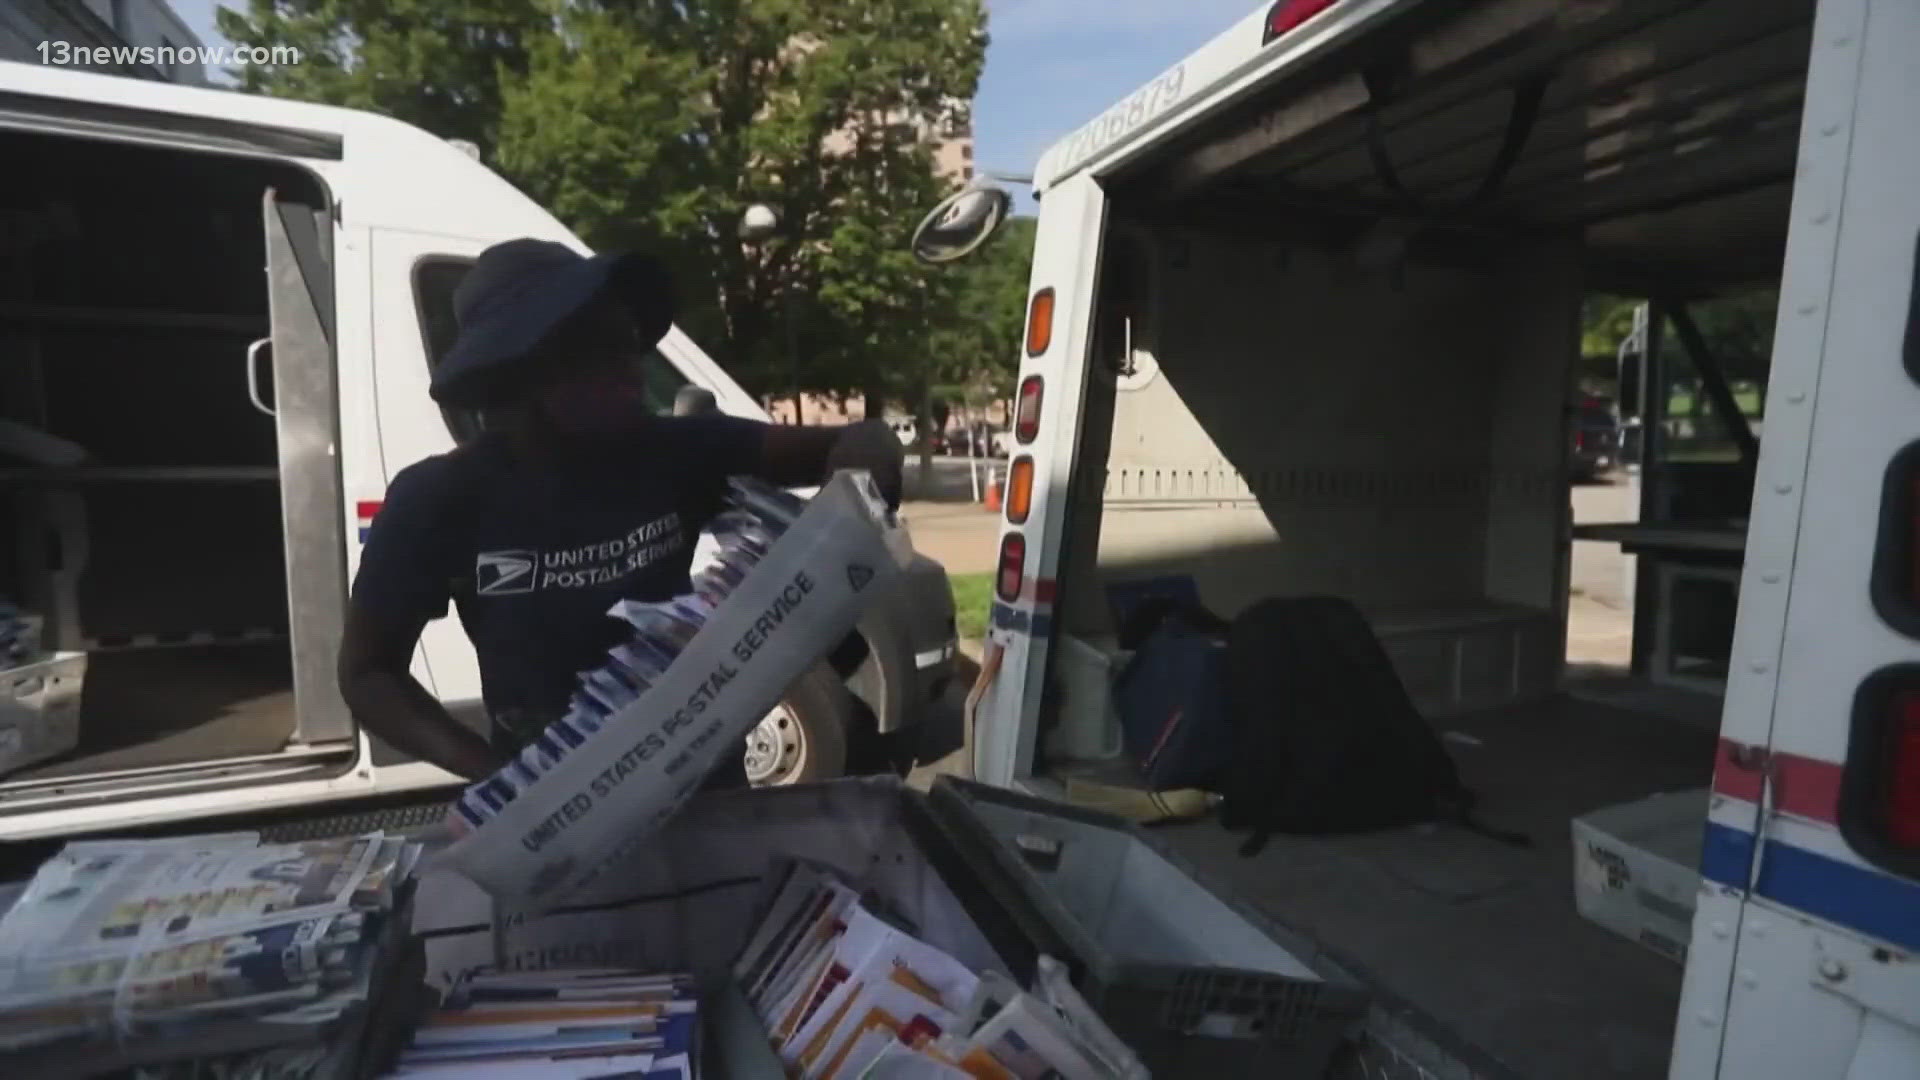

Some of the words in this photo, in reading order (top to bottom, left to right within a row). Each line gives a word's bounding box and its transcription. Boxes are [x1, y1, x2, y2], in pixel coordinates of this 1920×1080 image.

[544, 539, 624, 568] UNITED
[543, 563, 625, 588] POSTAL
[521, 793, 592, 852] UNITED
[590, 731, 666, 799] STATES
[663, 663, 737, 741] POSTAL
[733, 570, 815, 662] SERVICE
